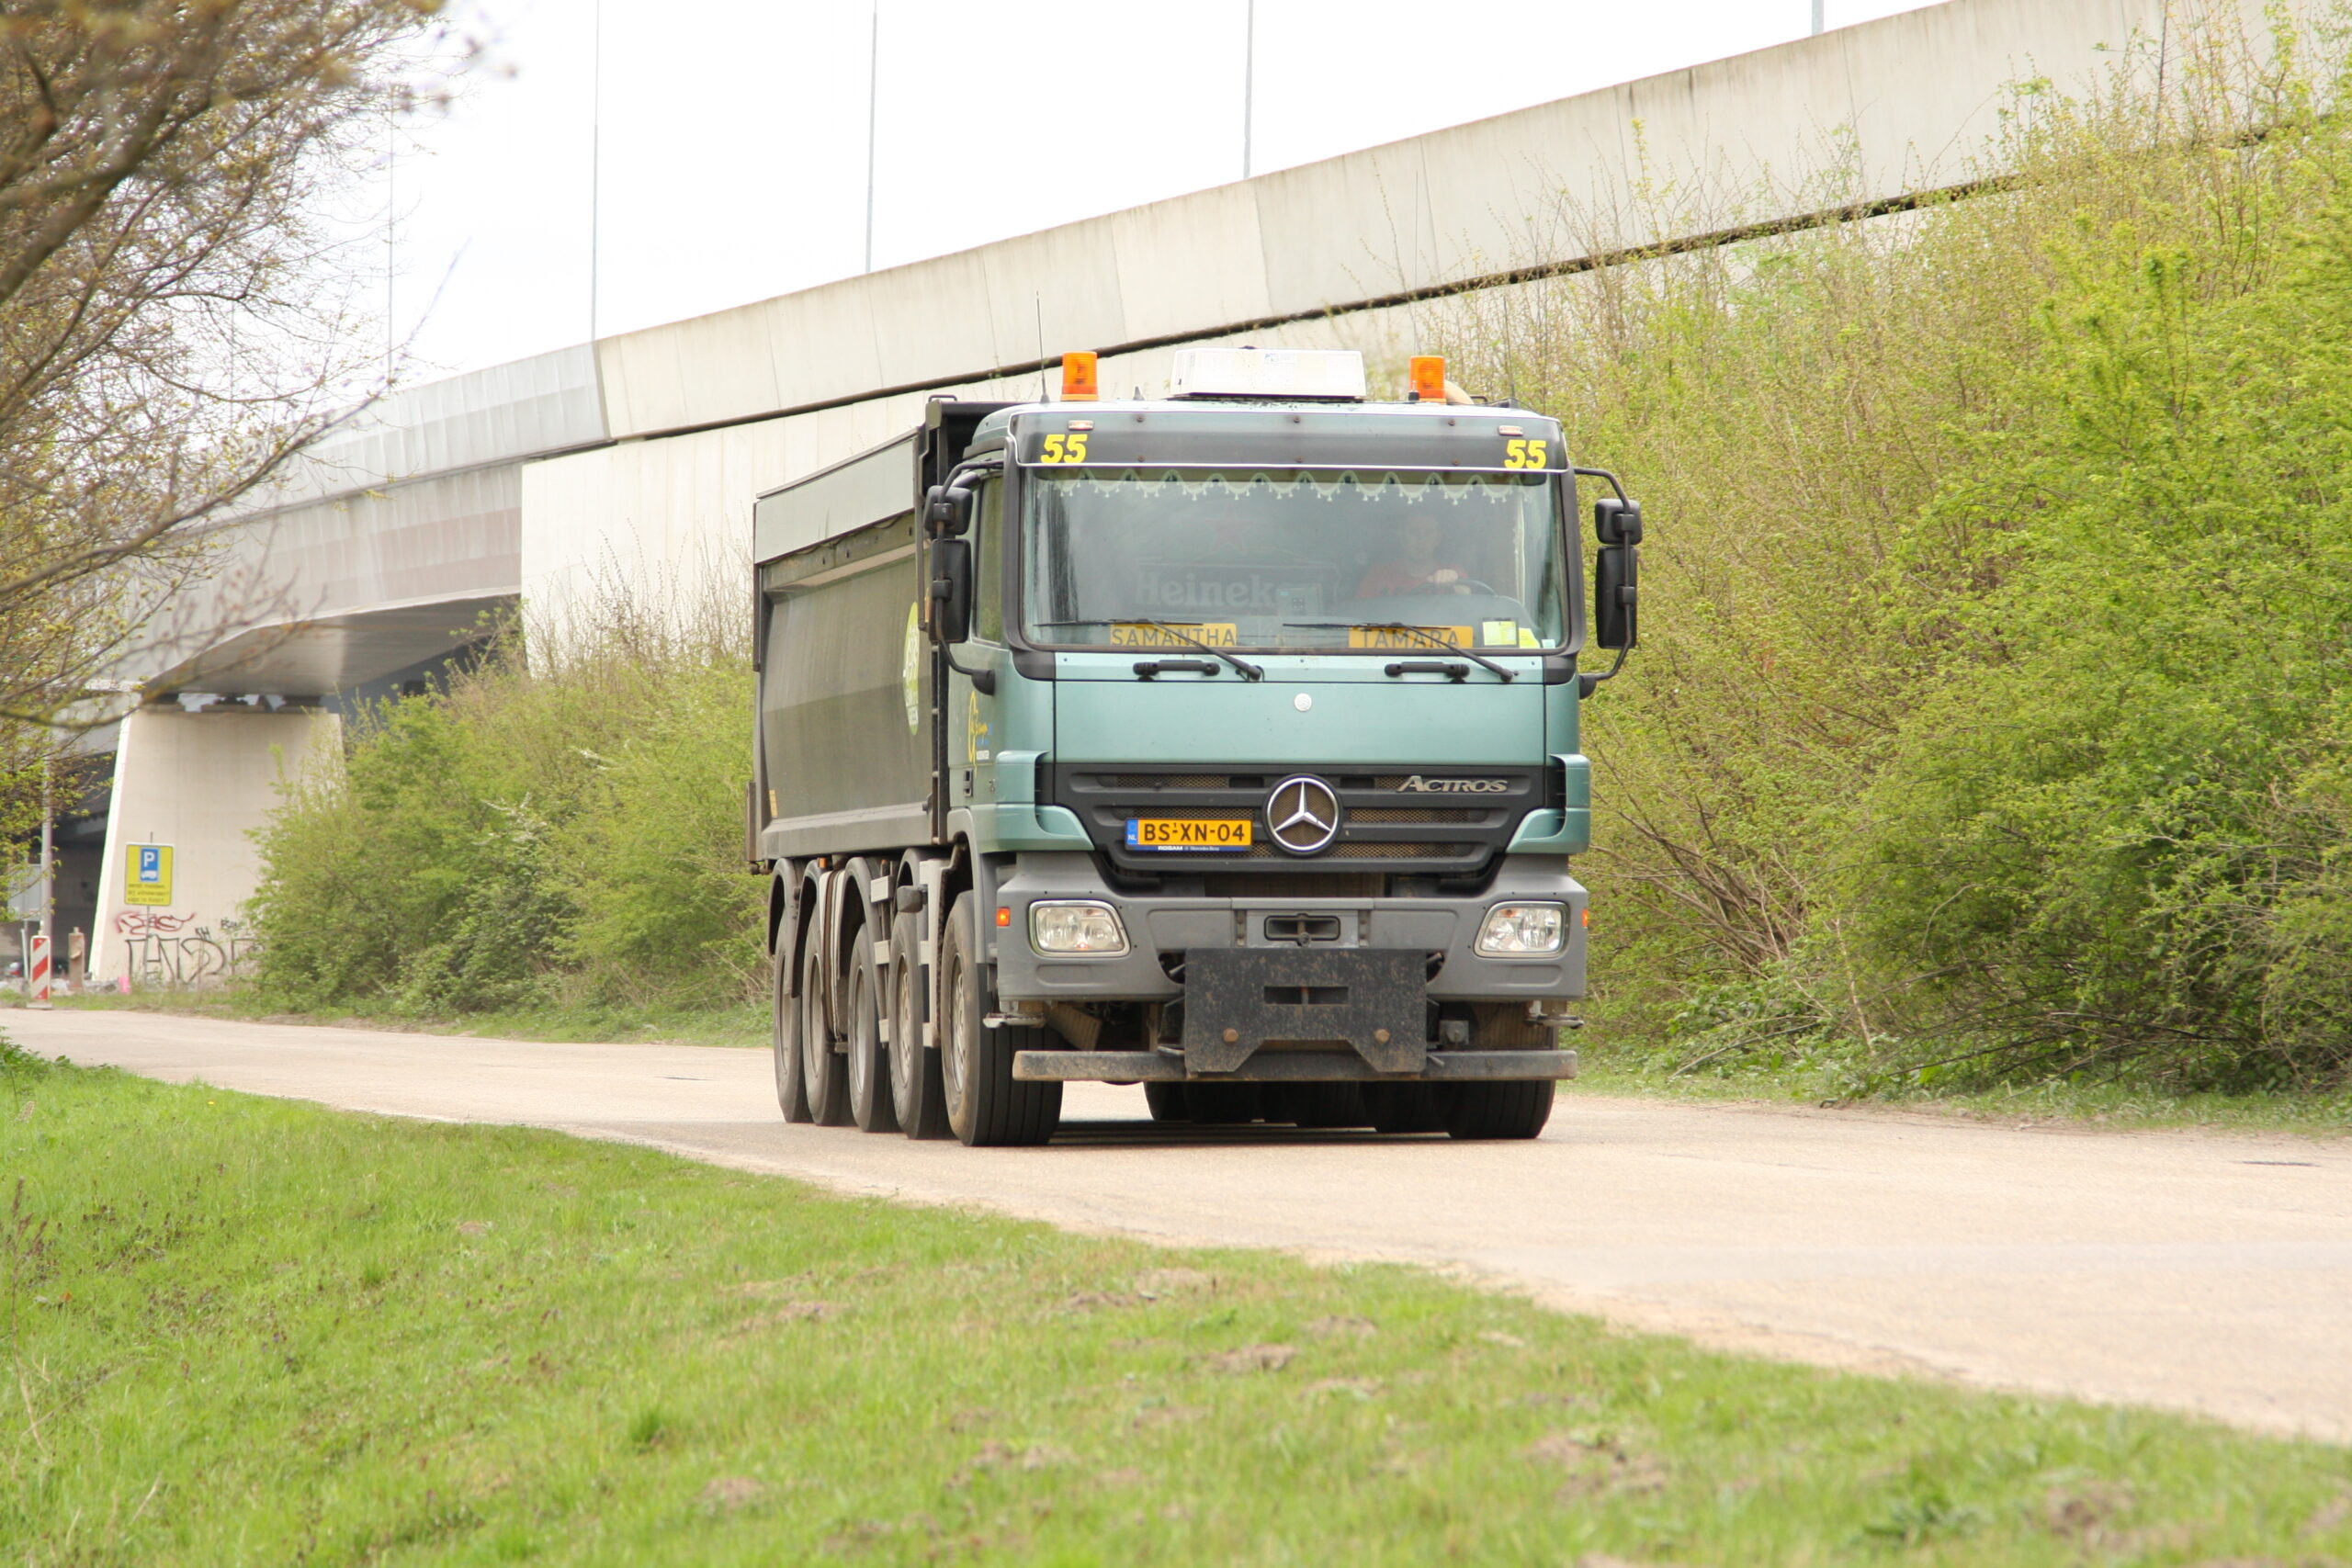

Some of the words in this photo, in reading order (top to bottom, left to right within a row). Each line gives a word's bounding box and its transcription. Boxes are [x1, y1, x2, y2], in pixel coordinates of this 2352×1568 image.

[1040, 434, 1088, 464] 55
[1504, 439, 1546, 468] 55
[1136, 571, 1306, 608] Heinek
[1111, 628, 1237, 647] SAMANTHA
[1362, 629, 1461, 649] TAMARA
[1143, 823, 1245, 841] BS-XN-04
[143, 852, 155, 867] P
